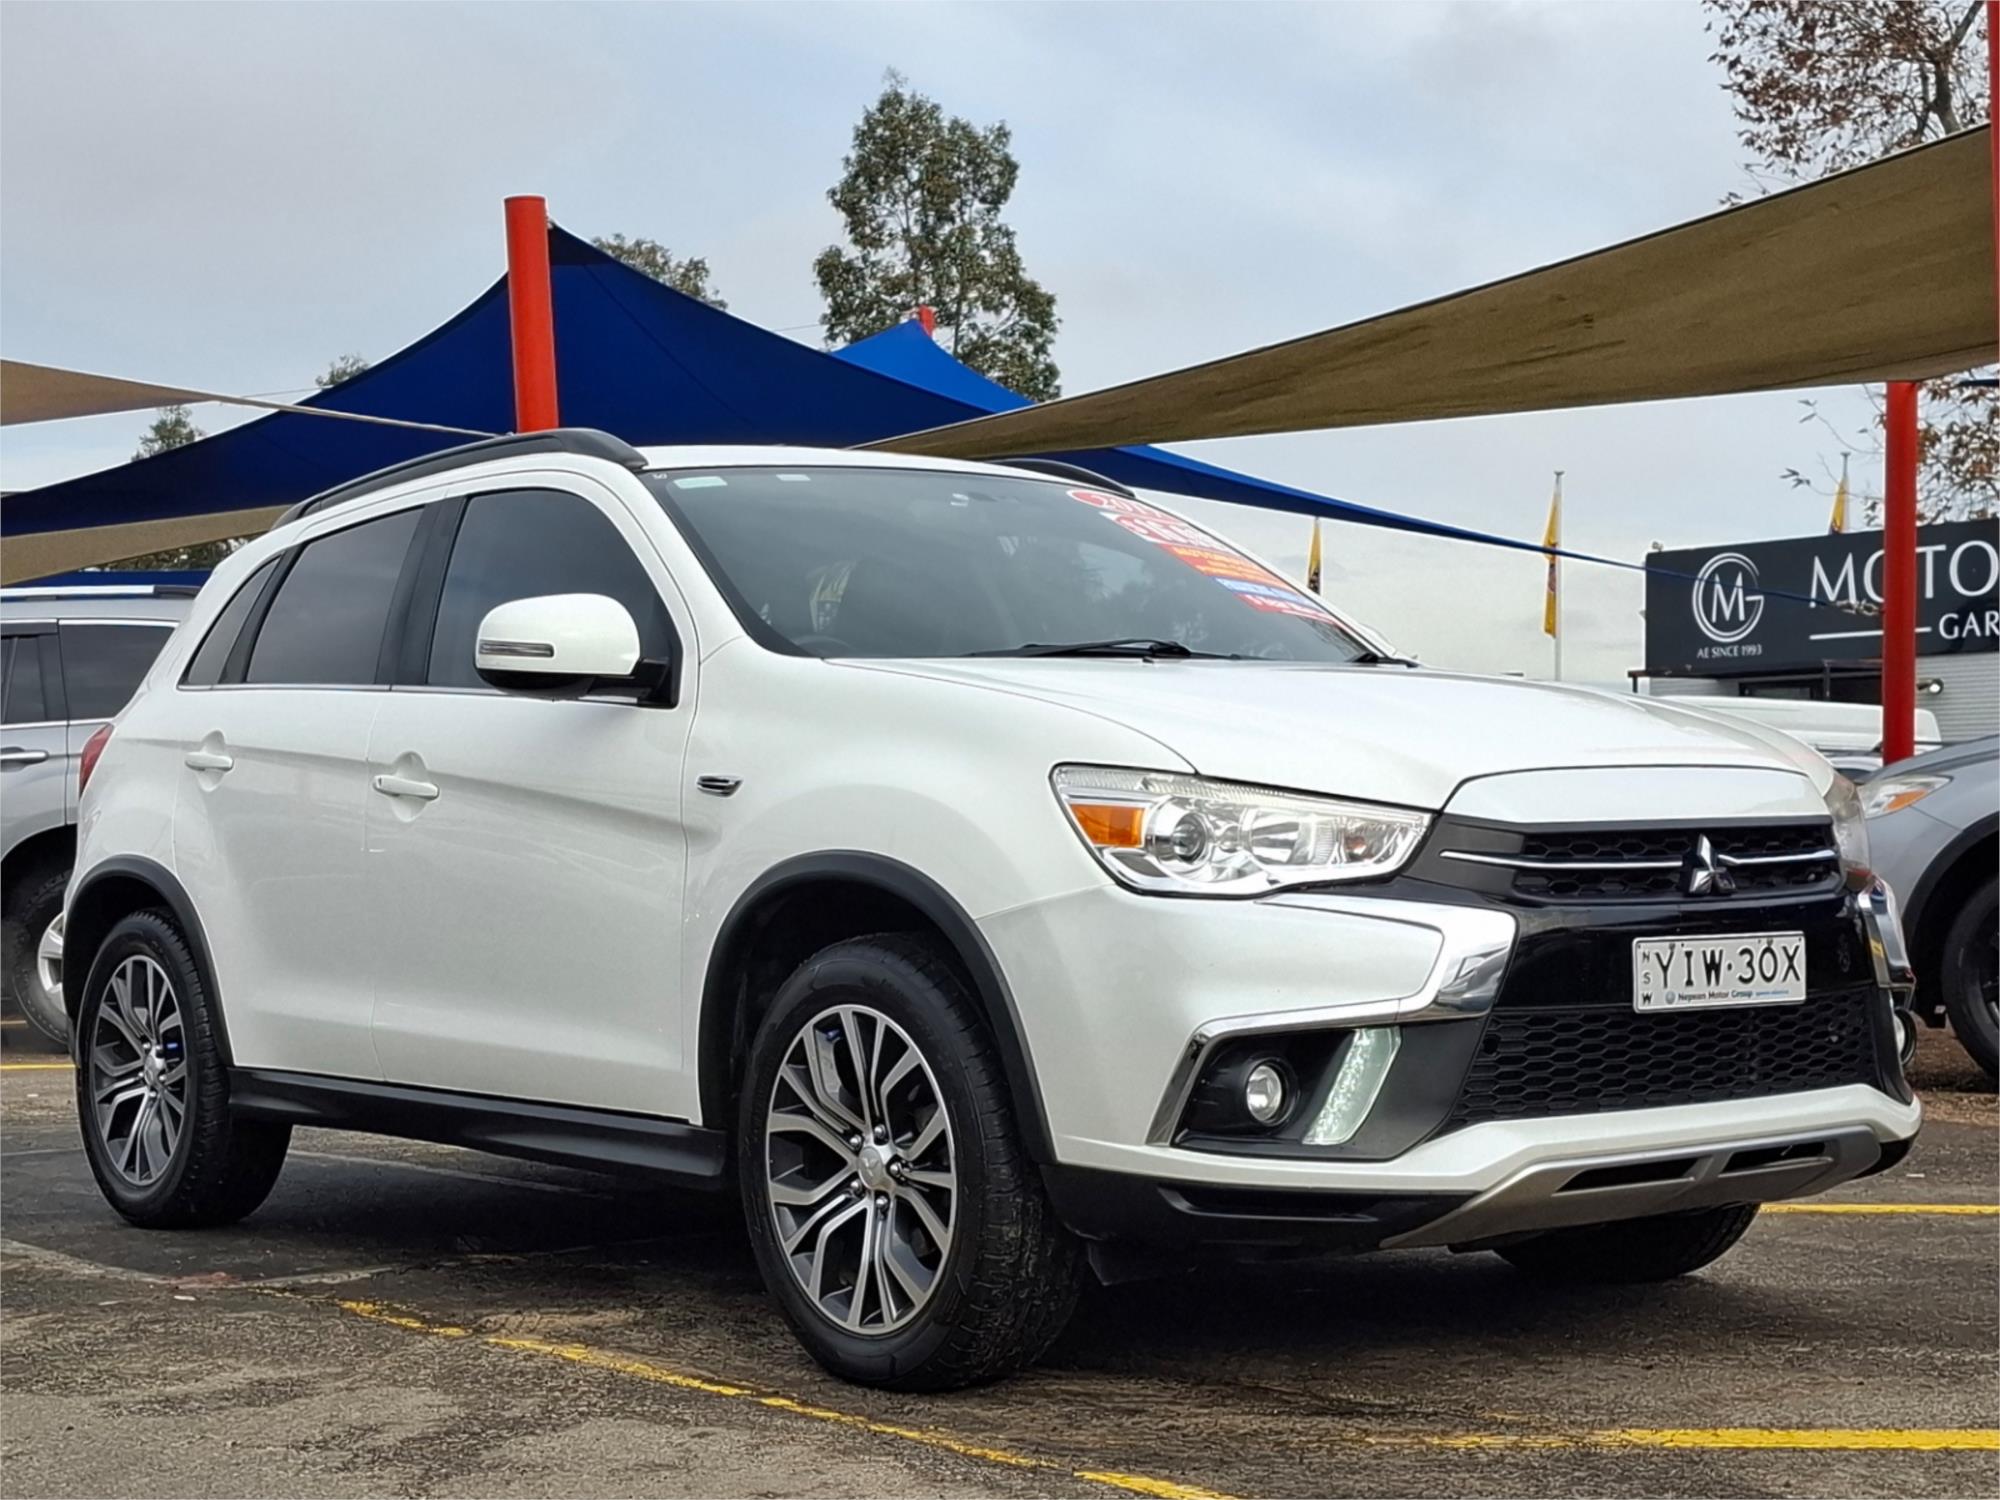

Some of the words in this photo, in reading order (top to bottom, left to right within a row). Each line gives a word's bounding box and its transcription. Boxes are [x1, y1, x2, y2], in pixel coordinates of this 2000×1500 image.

[1938, 610, 2000, 640] GAR
[1711, 644, 1739, 659] SINCE
[1708, 989, 1729, 999] Motor
[1731, 988, 1753, 998] Group
